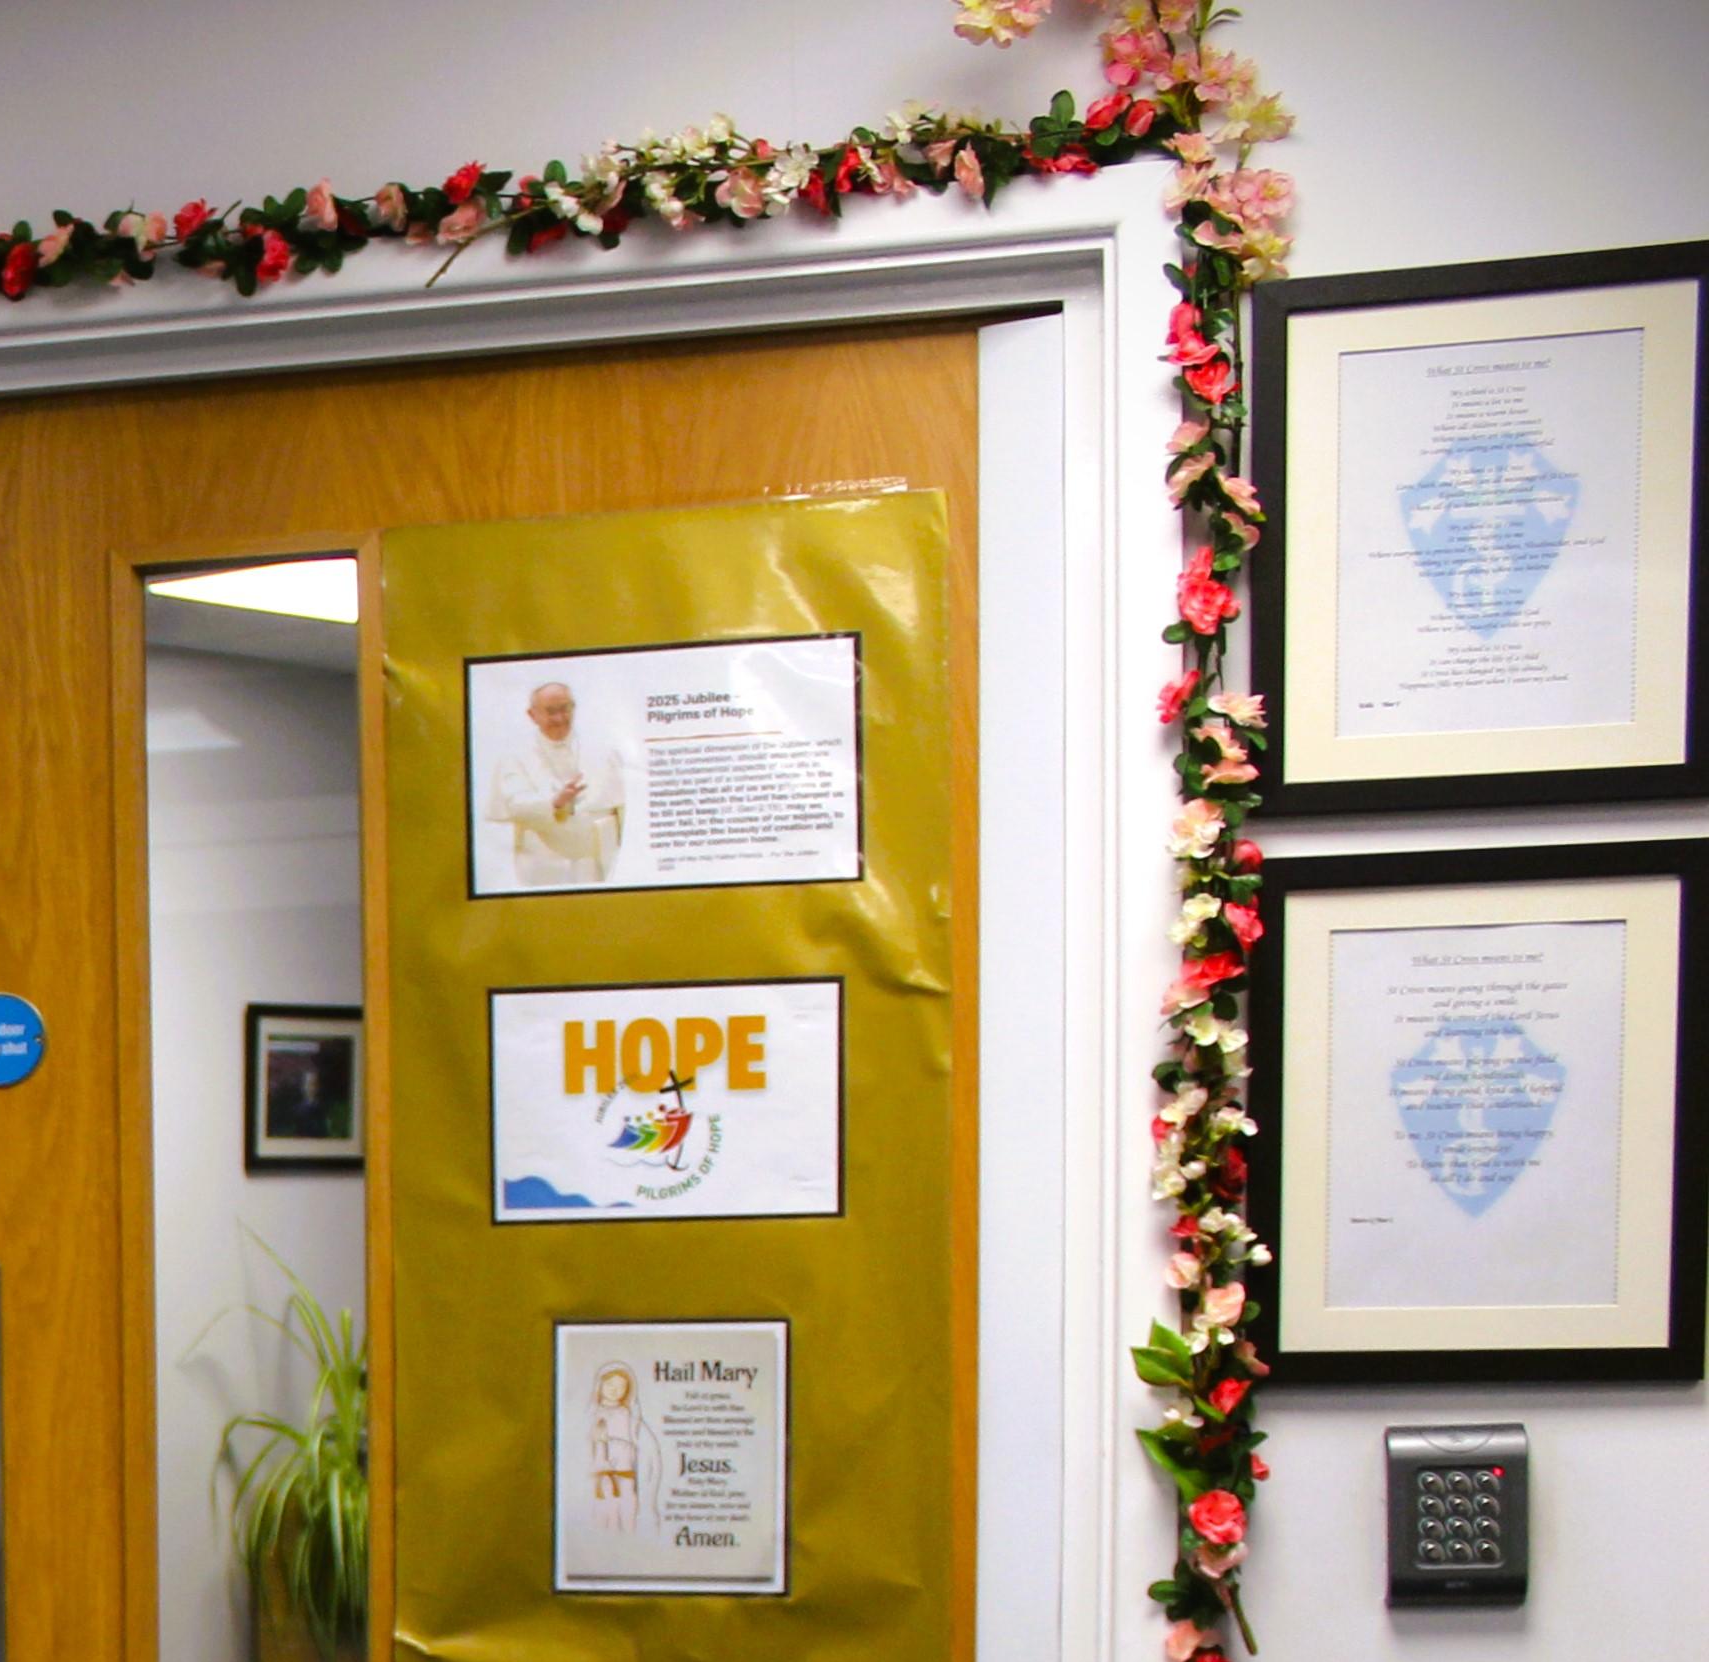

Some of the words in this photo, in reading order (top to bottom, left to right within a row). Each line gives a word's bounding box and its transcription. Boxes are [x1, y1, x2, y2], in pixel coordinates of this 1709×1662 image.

[647, 694, 680, 708] 2025
[682, 691, 731, 705] Jubilee
[647, 710, 701, 724] Pilgrims
[703, 707, 717, 719] of
[720, 706, 755, 720] Hope
[563, 1015, 767, 1094] HOPE
[636, 1173, 702, 1200] PILGRIMS
[698, 1155, 714, 1175] OF
[708, 1112, 723, 1153] HOPE
[653, 1360, 695, 1382] Hail
[700, 1359, 758, 1389] Mary
[678, 1452, 737, 1477] Jesus.
